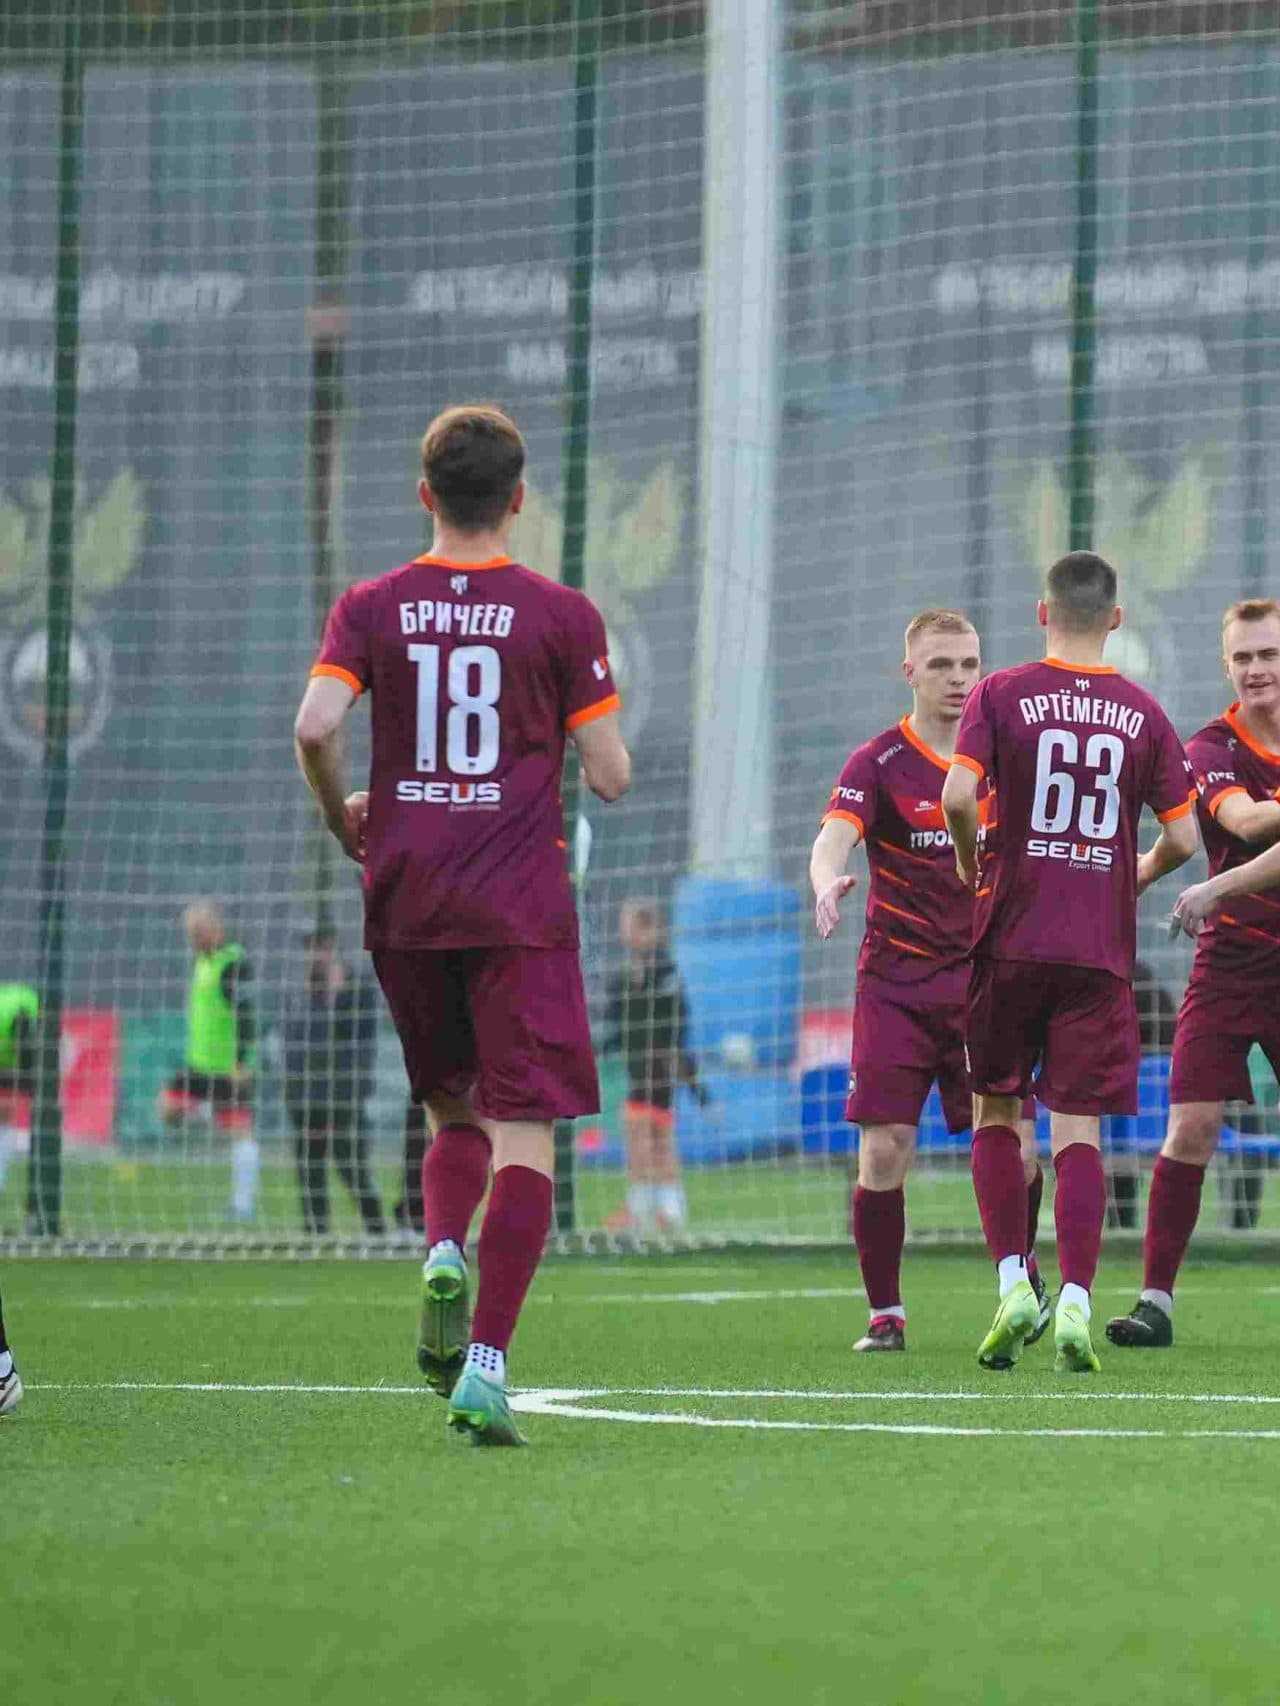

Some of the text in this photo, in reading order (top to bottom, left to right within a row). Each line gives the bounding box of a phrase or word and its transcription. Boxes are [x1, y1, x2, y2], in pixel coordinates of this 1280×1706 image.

[399, 600, 516, 638] БРИЧЕЕВ
[407, 643, 502, 776] 18
[1019, 687, 1144, 741] АРТЁМЕНКО
[396, 780, 503, 804] SEUS
[1031, 727, 1125, 840] 63
[1027, 839, 1113, 865] SEUS
